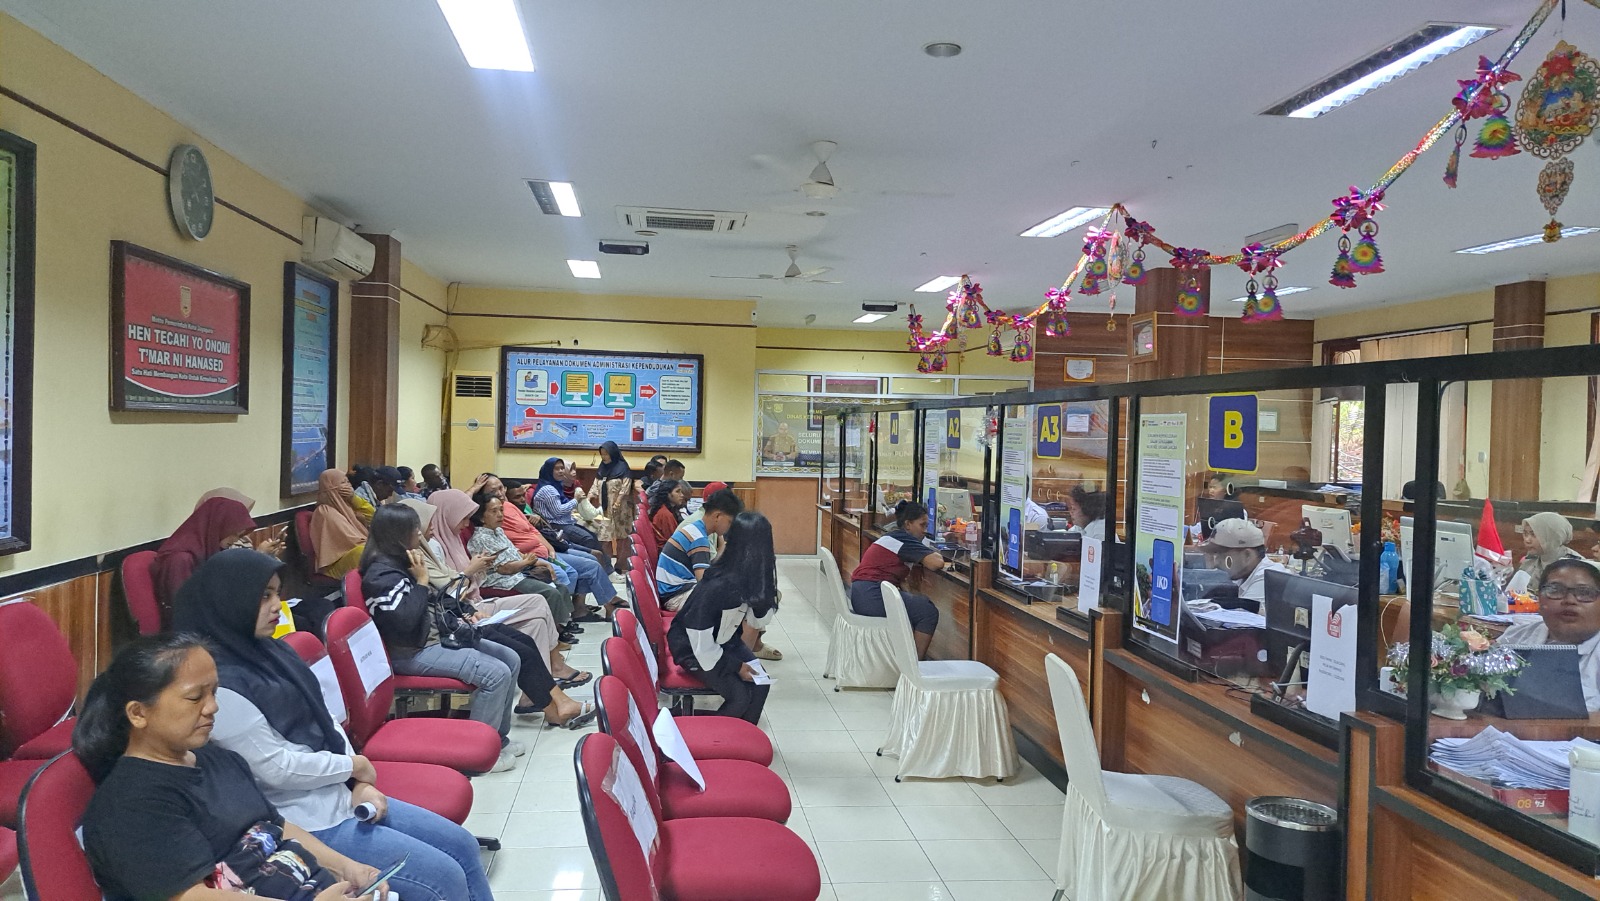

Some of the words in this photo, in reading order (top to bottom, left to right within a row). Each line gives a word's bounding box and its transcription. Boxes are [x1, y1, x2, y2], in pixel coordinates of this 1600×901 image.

[128, 324, 151, 341] HEN
[154, 328, 189, 348] TECAHI
[191, 336, 203, 350] YO
[205, 339, 231, 355] ONOMI
[172, 353, 183, 367] NI
[185, 355, 224, 372] HANASED
[532, 358, 564, 367] PELAYANAN
[565, 360, 591, 368] DOKUMEN
[593, 361, 631, 369] ADMINISTRASI
[631, 363, 674, 371] KEPENDUDUKAN
[131, 367, 143, 376] Satu
[143, 369, 153, 377] Hati
[153, 370, 179, 380] Membangun
[179, 372, 188, 380] Kota
[188, 373, 200, 381] Untuk
[891, 421, 898, 436] A1
[948, 417, 959, 438] A2
[1040, 415, 1059, 443] A3
[1224, 410, 1244, 449] B
[1156, 575, 1168, 590] IKD
[1517, 799, 1531, 809] 80
[1534, 799, 1545, 808] F4
